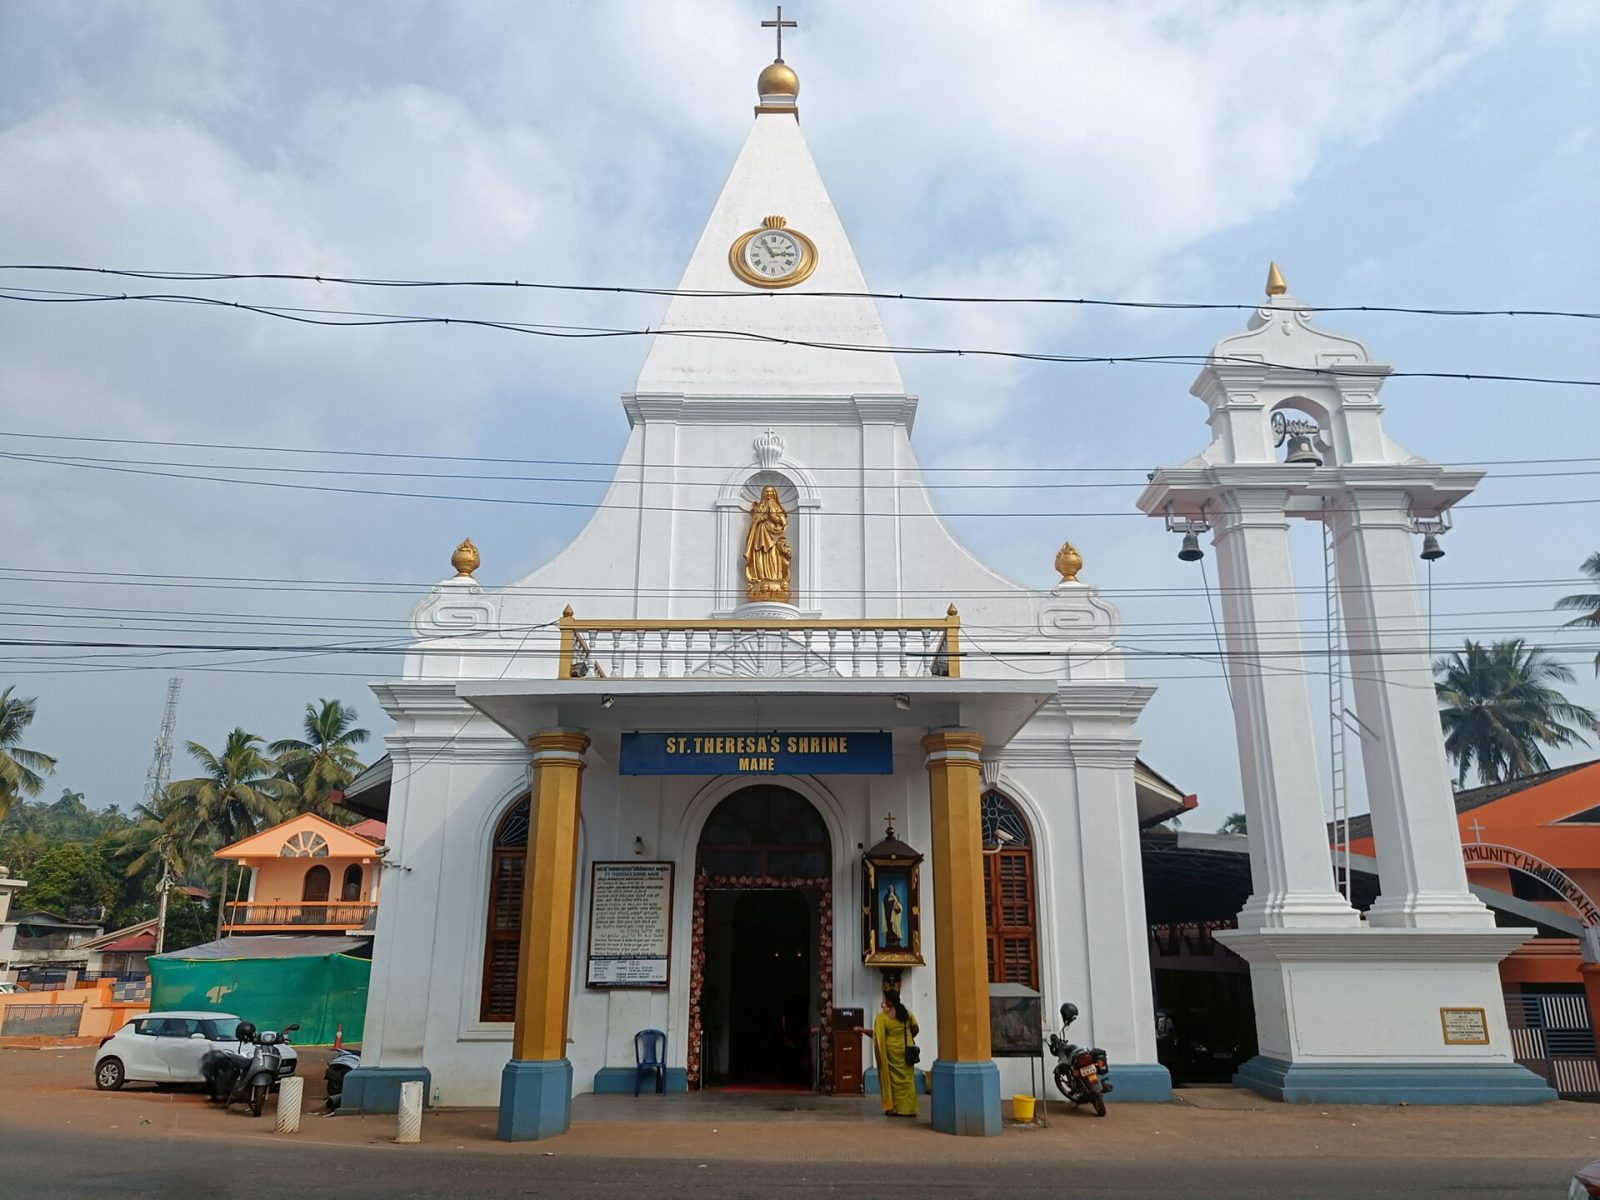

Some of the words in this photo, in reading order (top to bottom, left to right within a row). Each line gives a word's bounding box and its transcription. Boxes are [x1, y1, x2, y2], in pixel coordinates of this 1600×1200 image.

[787, 737, 847, 753] SHRINE
[739, 757, 774, 771] MAHE
[1565, 884, 1599, 926] MAHE
